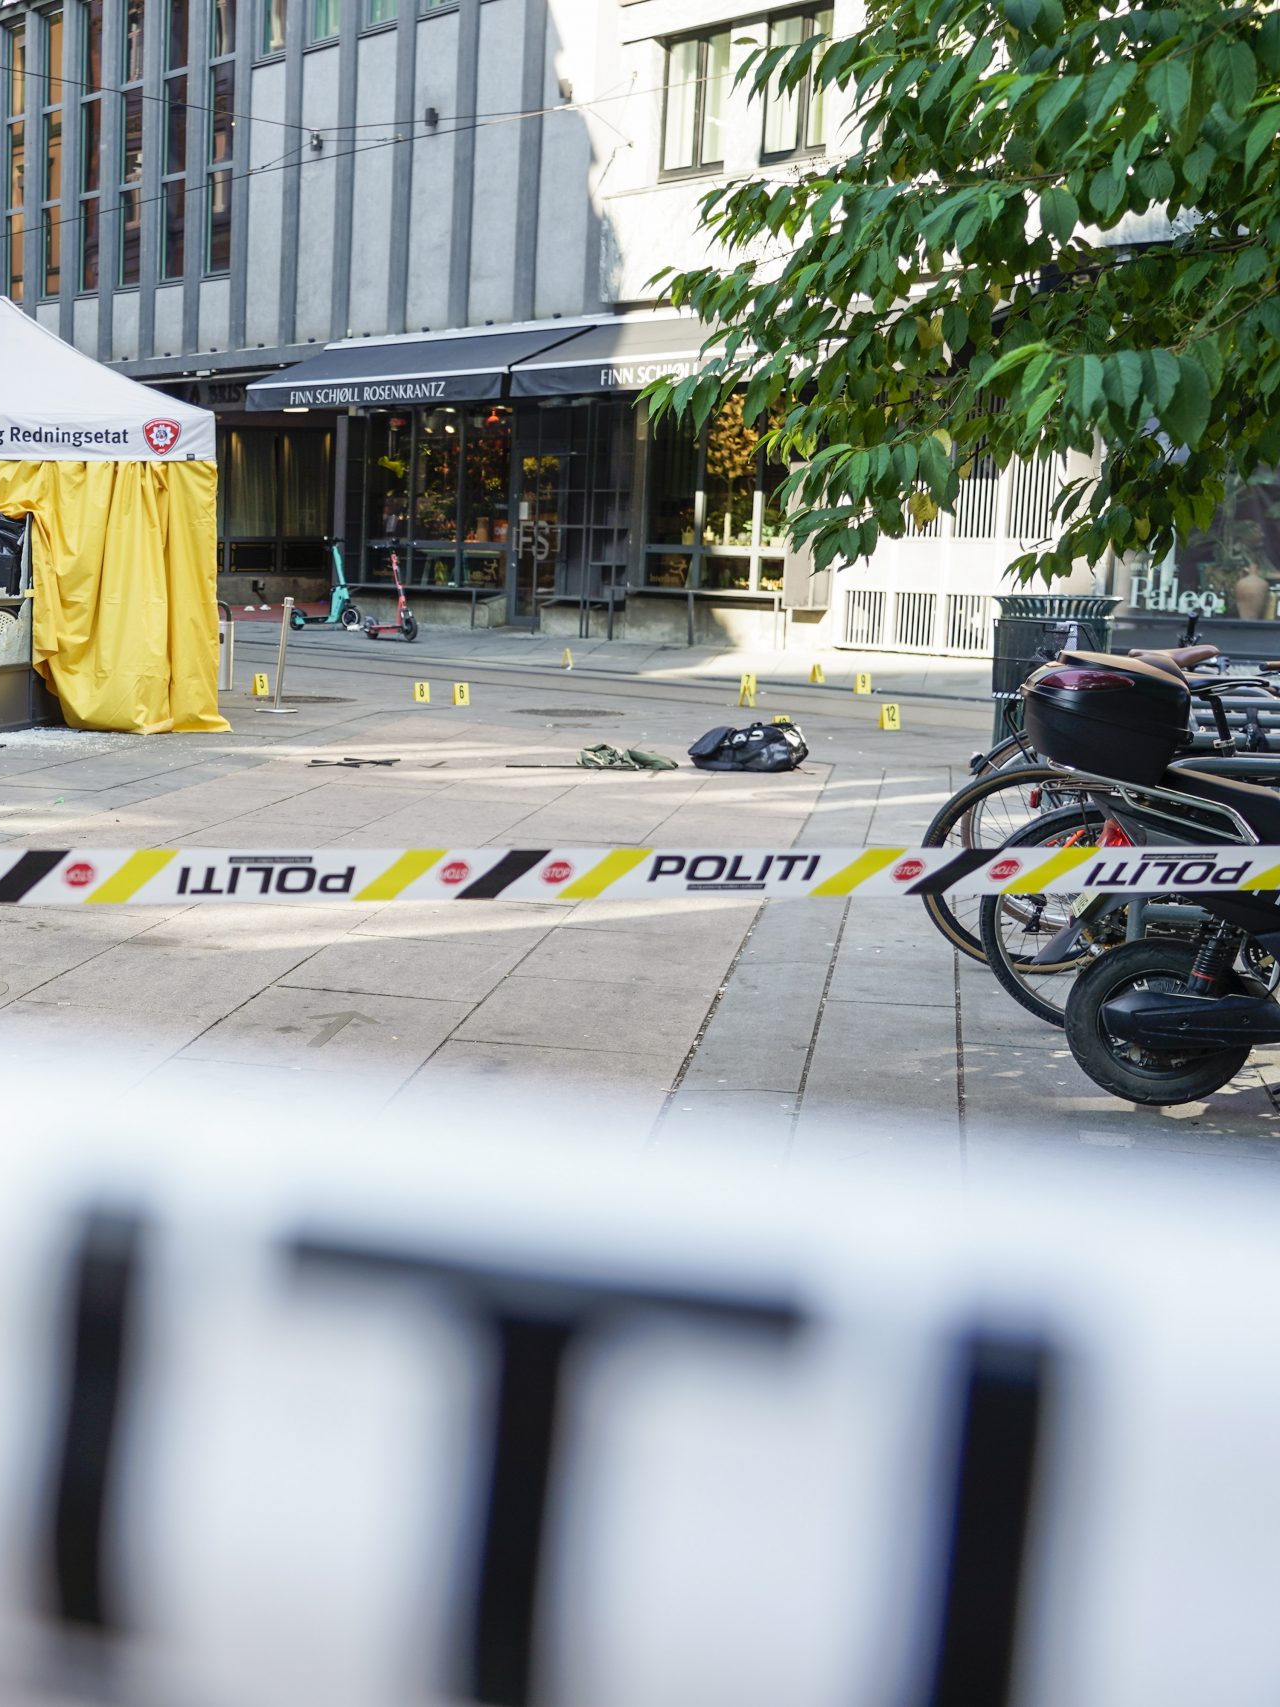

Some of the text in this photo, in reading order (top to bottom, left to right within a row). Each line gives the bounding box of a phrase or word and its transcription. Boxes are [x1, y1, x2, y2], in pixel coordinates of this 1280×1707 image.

[600, 367, 633, 386] FINN
[290, 382, 446, 405] FINN SCHJØLL ROSENKRANTZ
[10, 426, 129, 447] Redningsetat
[885, 705, 897, 722] 12
[542, 866, 571, 878] STOP
[646, 855, 821, 882] POLITI
[894, 864, 922, 876] STOP
[990, 864, 1019, 876] STOP
[1083, 861, 1254, 887] POLITI
[176, 866, 356, 895] POLITI
